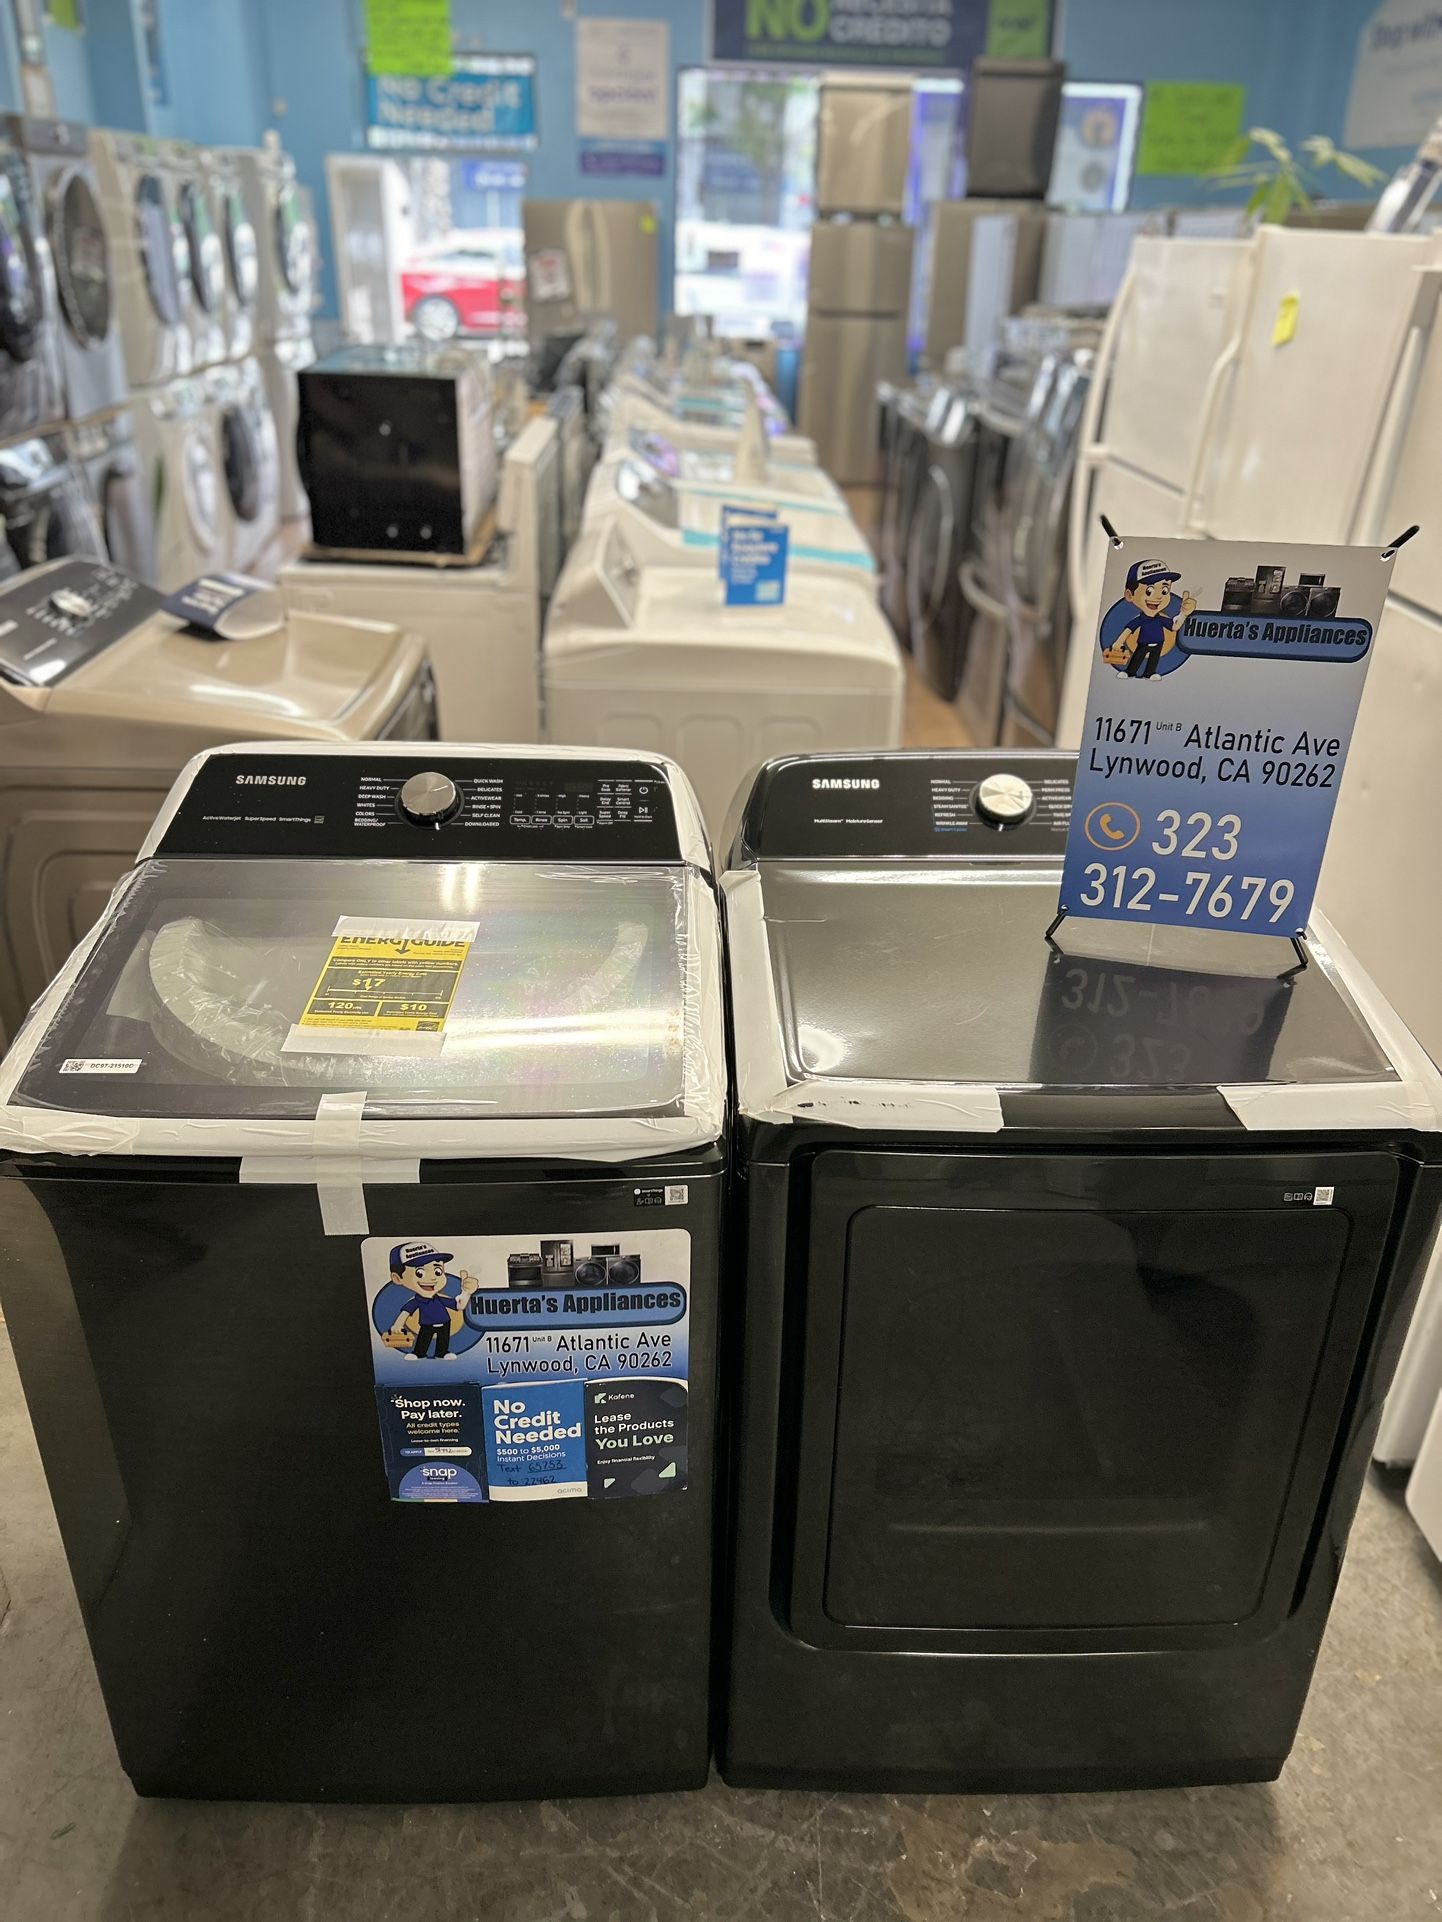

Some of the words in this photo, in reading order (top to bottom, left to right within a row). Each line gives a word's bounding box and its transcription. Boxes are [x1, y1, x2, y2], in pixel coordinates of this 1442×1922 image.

[426, 76, 521, 108] Credit
[379, 101, 496, 131] Needed
[1183, 617, 1259, 641] Huerta's
[1261, 623, 1368, 646] Appliances
[1095, 716, 1152, 745] 11671
[1156, 721, 1174, 731] Unit
[1175, 722, 1183, 732] B
[1184, 724, 1285, 754] Atlantic
[1292, 731, 1341, 757] Ave
[1089, 748, 1207, 784] Lynwood,
[1217, 757, 1251, 783] CA
[1262, 760, 1337, 788] 90262
[235, 774, 307, 786] SAMSUNG
[812, 778, 880, 790] SAMSUNG
[1151, 808, 1243, 861] 323
[1079, 862, 1296, 924] 312-7679
[352, 978, 386, 989] $17
[328, 1001, 354, 1010] 120
[399, 1003, 428, 1011] $10
[471, 1295, 558, 1315] Huerta's
[563, 1291, 681, 1314] Appliances
[486, 1336, 530, 1353] 11671
[556, 1334, 630, 1352] Atlantic
[636, 1331, 672, 1349] Ave
[487, 1355, 578, 1377] Lynwood,
[585, 1354, 611, 1371] CA
[617, 1351, 672, 1370] 90262
[395, 1398, 430, 1409] Shop
[433, 1399, 466, 1407] now.
[608, 1393, 635, 1401] Kafene
[493, 1400, 526, 1414] No
[401, 1410, 426, 1421] Pay
[428, 1410, 462, 1418] later.
[494, 1411, 561, 1430] Credit
[594, 1413, 632, 1424] Lease
[495, 1423, 582, 1445] Needed
[594, 1425, 615, 1435] the
[618, 1419, 674, 1432] Products
[595, 1438, 629, 1450] You
[632, 1433, 674, 1447] Love
[496, 1448, 518, 1456] $500
[531, 1444, 560, 1454] $5,000
[497, 1455, 525, 1463] Instant
[526, 1451, 566, 1462] Decisions
[422, 1467, 458, 1480] snap
[498, 1463, 521, 1473] Text
[508, 1477, 519, 1486] to
